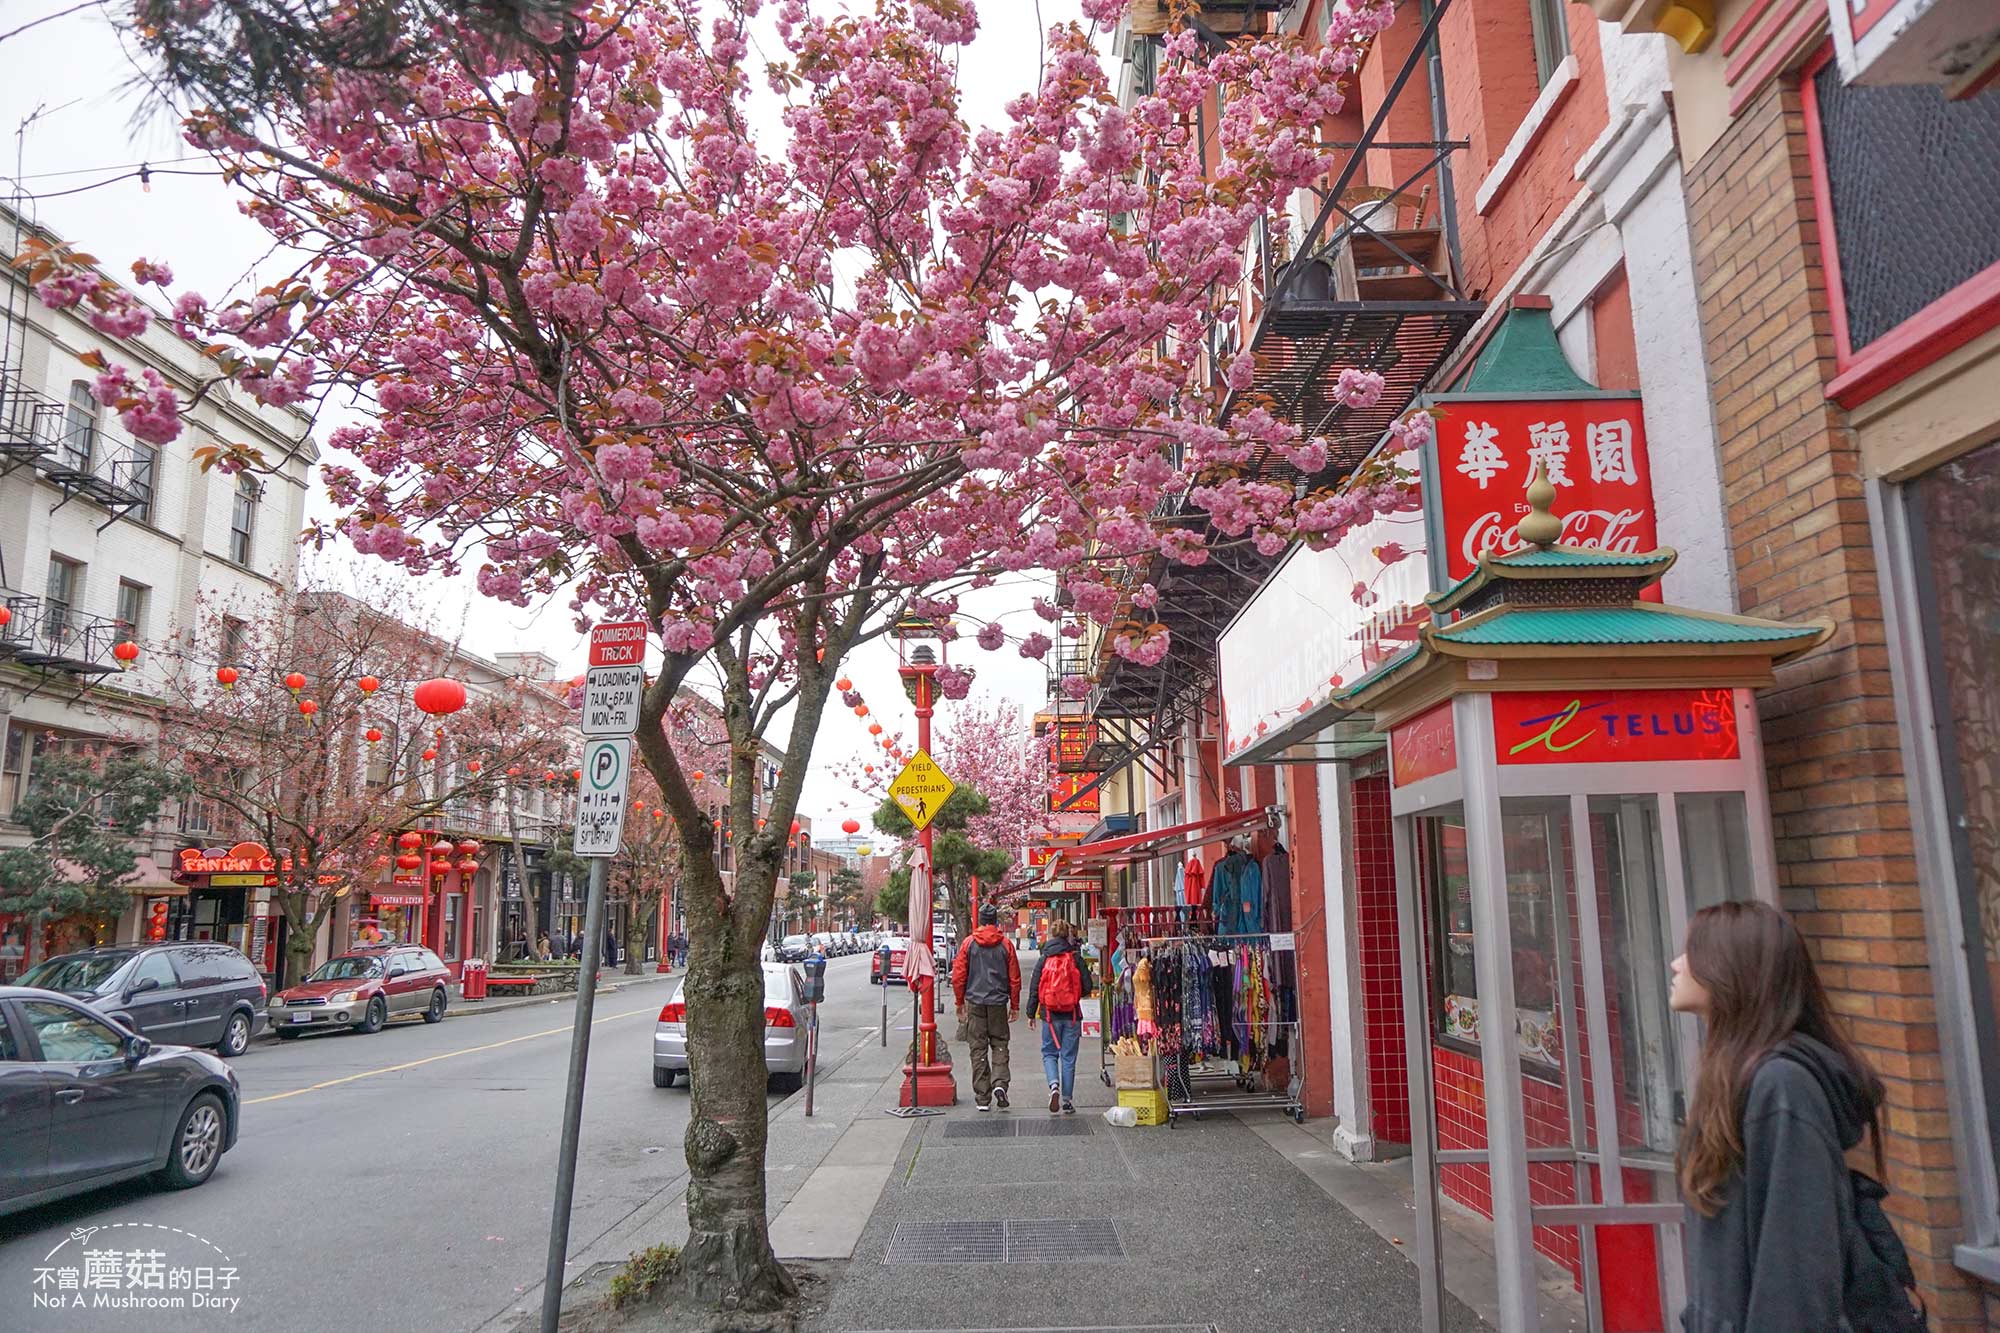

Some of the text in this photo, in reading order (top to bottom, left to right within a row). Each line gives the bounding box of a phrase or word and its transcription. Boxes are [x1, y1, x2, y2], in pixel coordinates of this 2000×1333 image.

[592, 627, 645, 643] COMMERCIAL
[601, 646, 633, 661] TRUCK
[598, 672, 630, 686] LOADING
[1601, 711, 1721, 736] TELUS
[596, 752, 612, 780] P
[911, 763, 932, 771] YIELD
[896, 784, 946, 794] PEDESTRIANS
